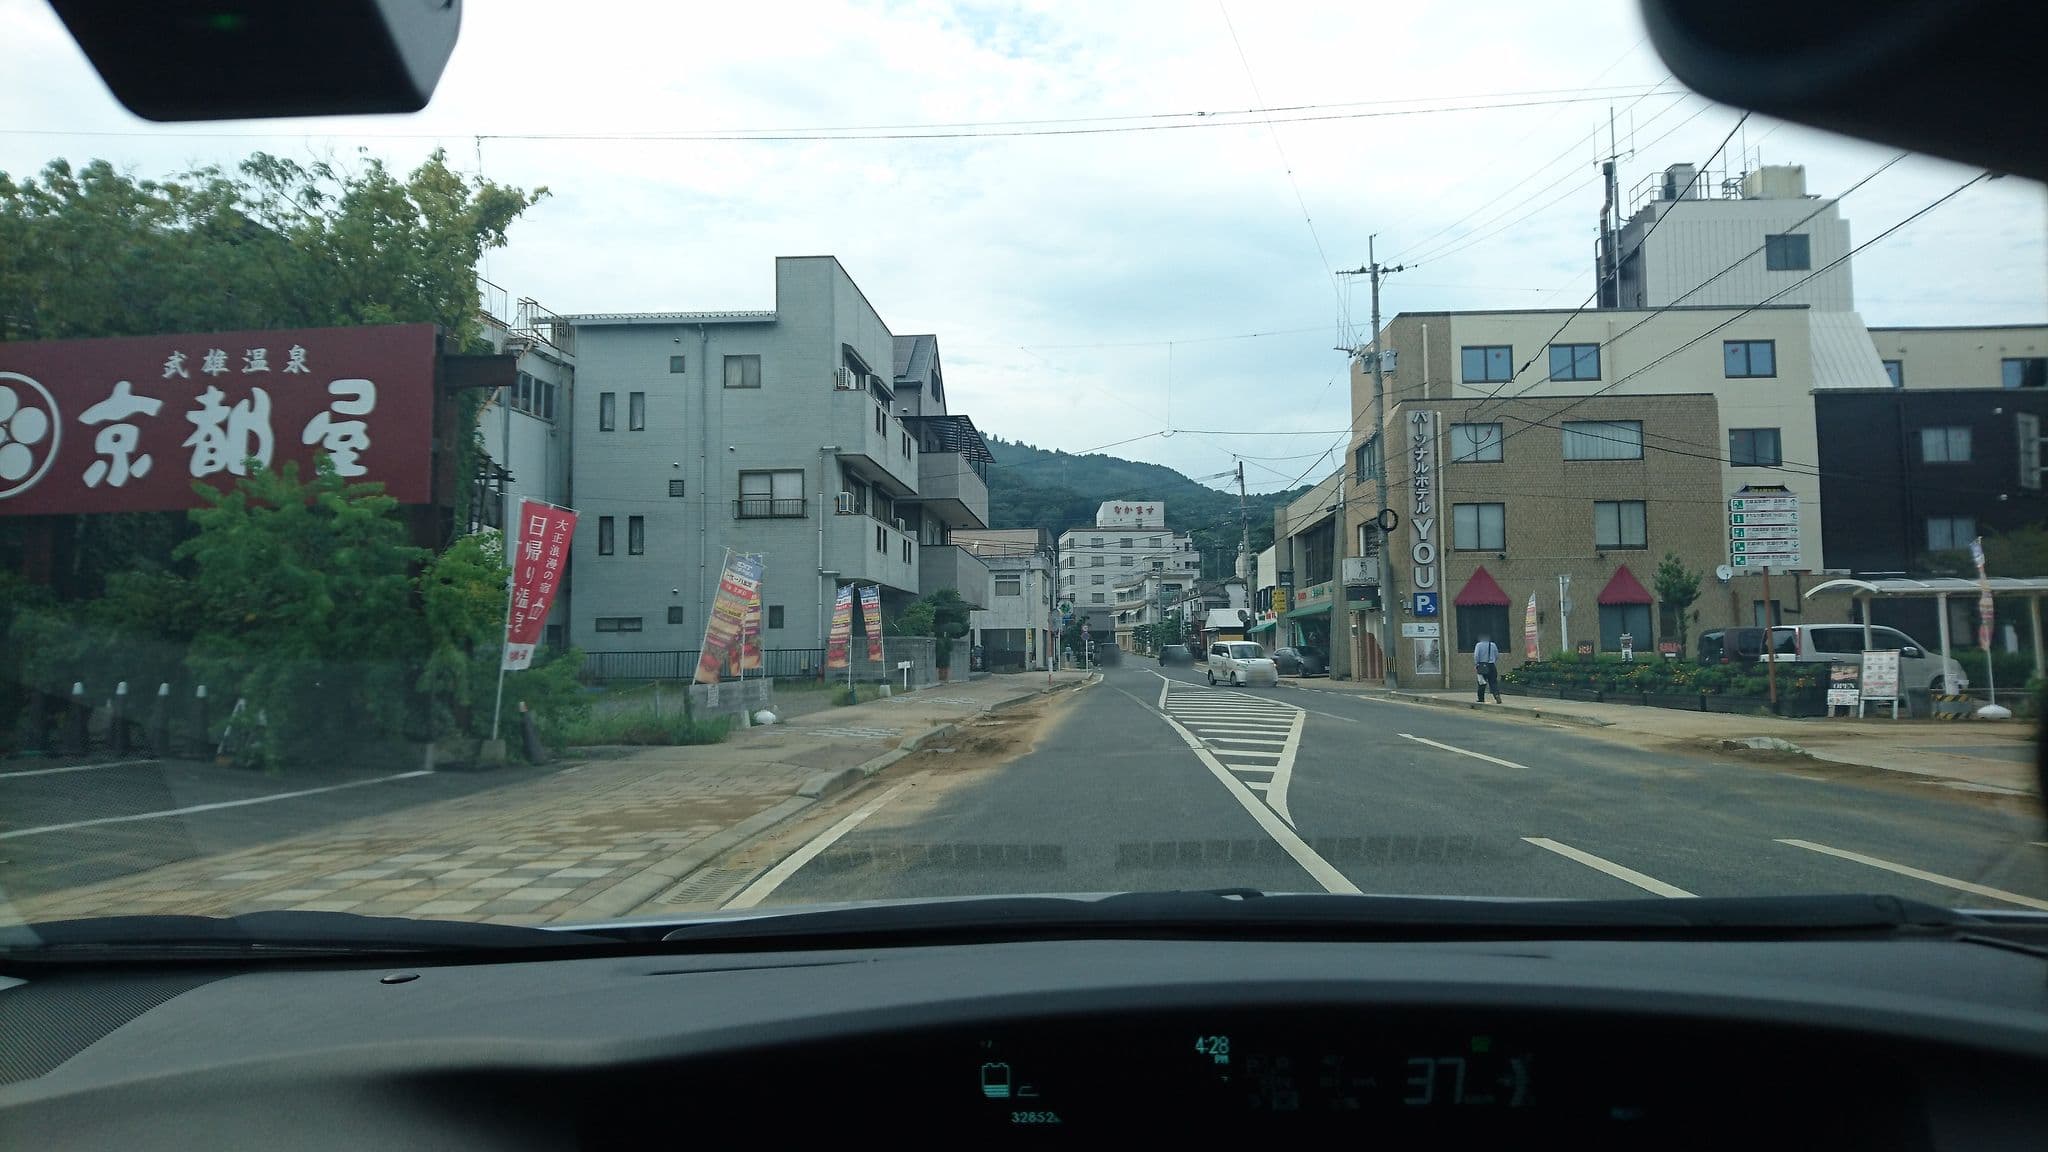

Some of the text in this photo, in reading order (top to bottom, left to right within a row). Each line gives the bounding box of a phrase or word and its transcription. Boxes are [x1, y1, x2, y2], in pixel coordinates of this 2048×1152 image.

[161, 344, 312, 380] 武雄温泉
[77, 378, 378, 489] 京都屋
[1114, 505, 1155, 515] なかます
[1412, 410, 1435, 590] パーソナルホテル YOU
[514, 514, 548, 634] 日帰り温泉
[539, 518, 569, 595] 大正浪漫の宿
[1416, 595, 1431, 612] P
[1195, 1036, 1230, 1055] 4:28
